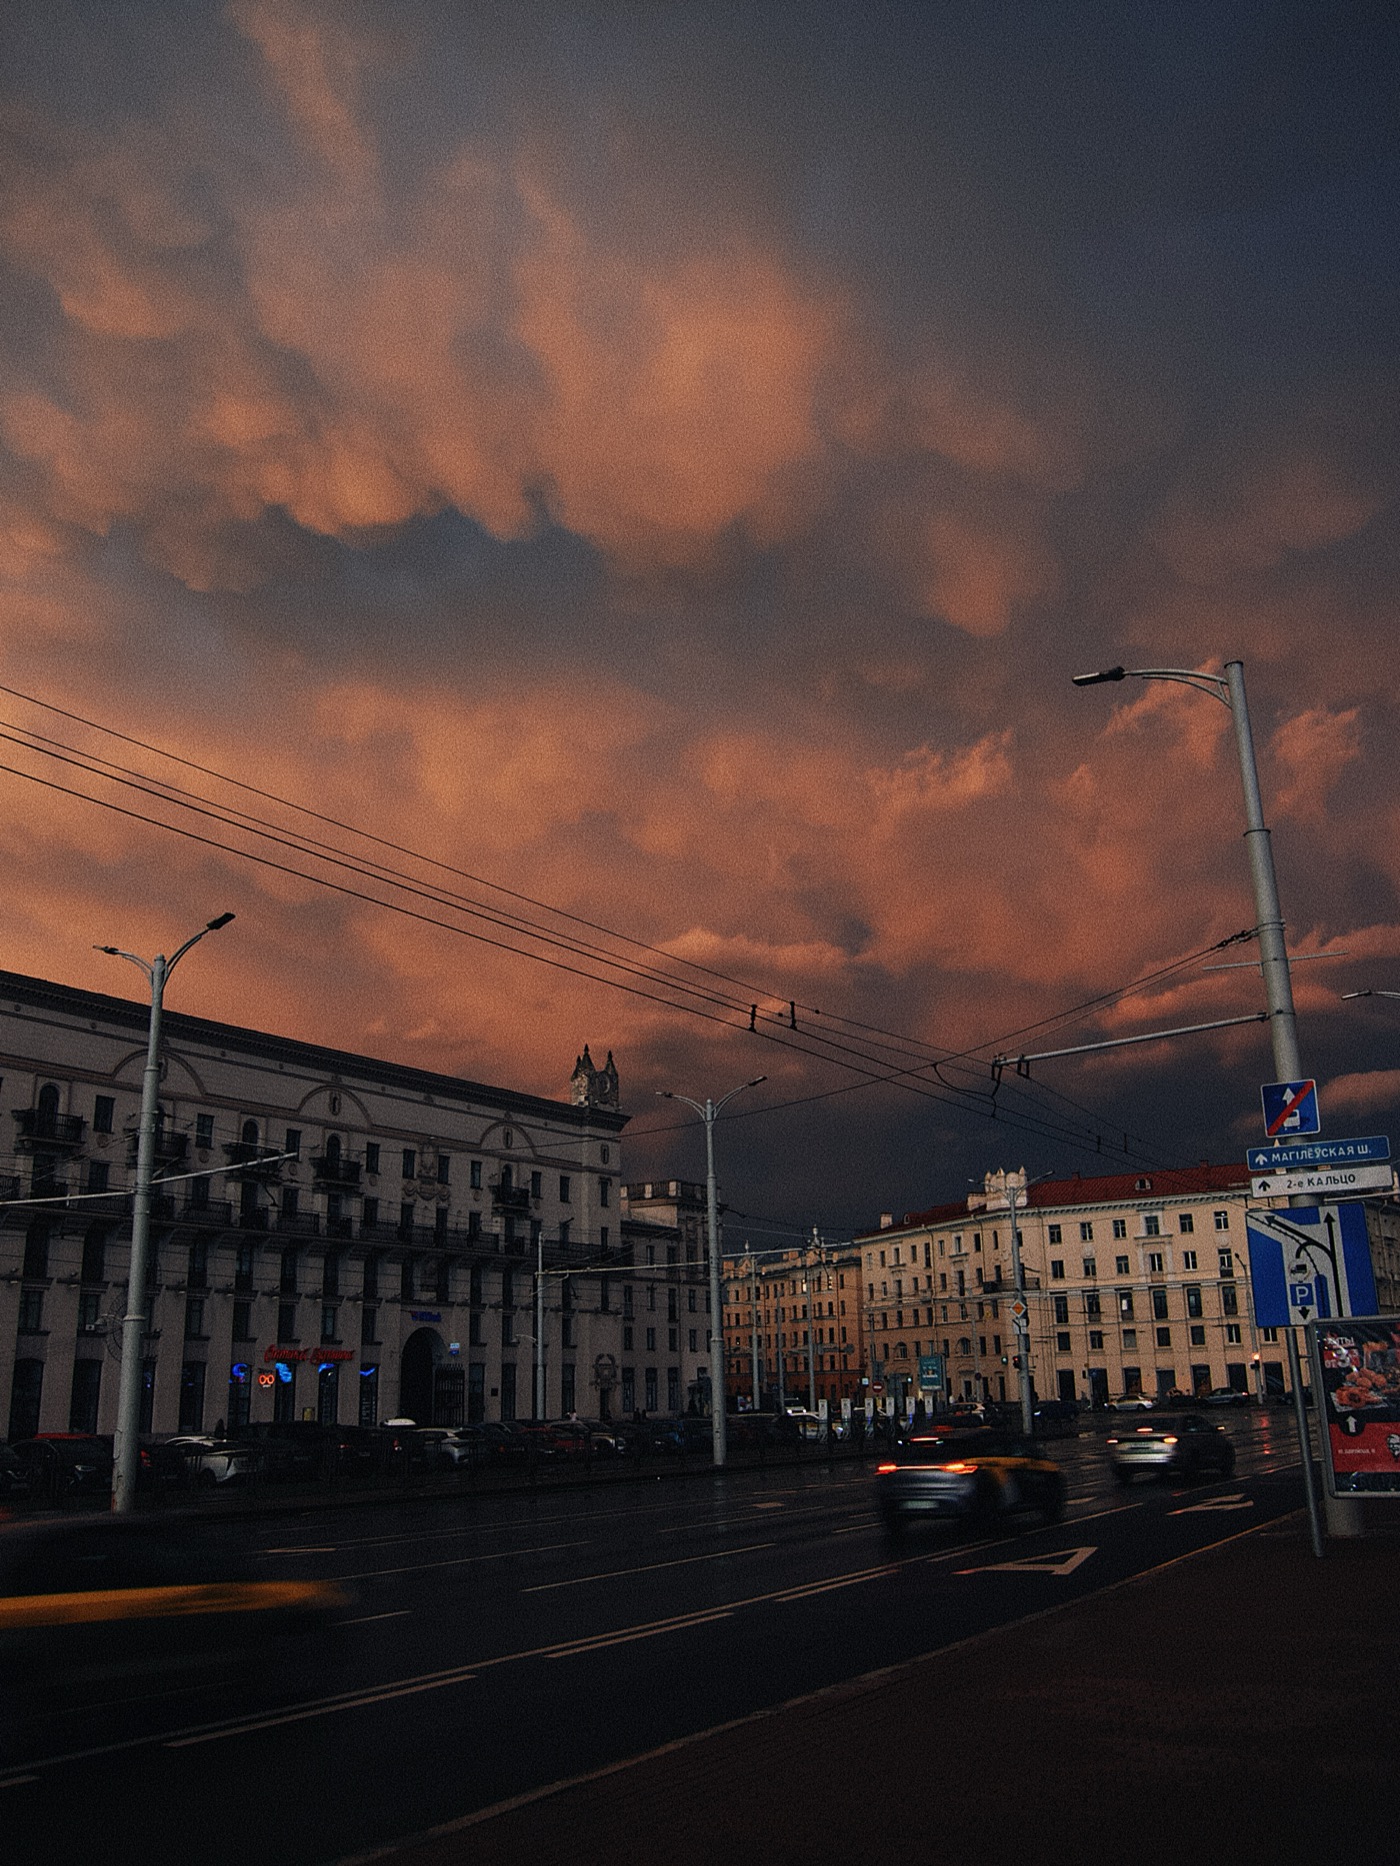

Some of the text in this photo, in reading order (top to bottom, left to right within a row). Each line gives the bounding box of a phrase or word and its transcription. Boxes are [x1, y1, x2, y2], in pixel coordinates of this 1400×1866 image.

[1271, 1144, 1372, 1163] МАГІЛЁЎСКАЯ Ш.
[1287, 1174, 1356, 1189] 2-е КАЛЬЦО
[1295, 1286, 1309, 1304] P
